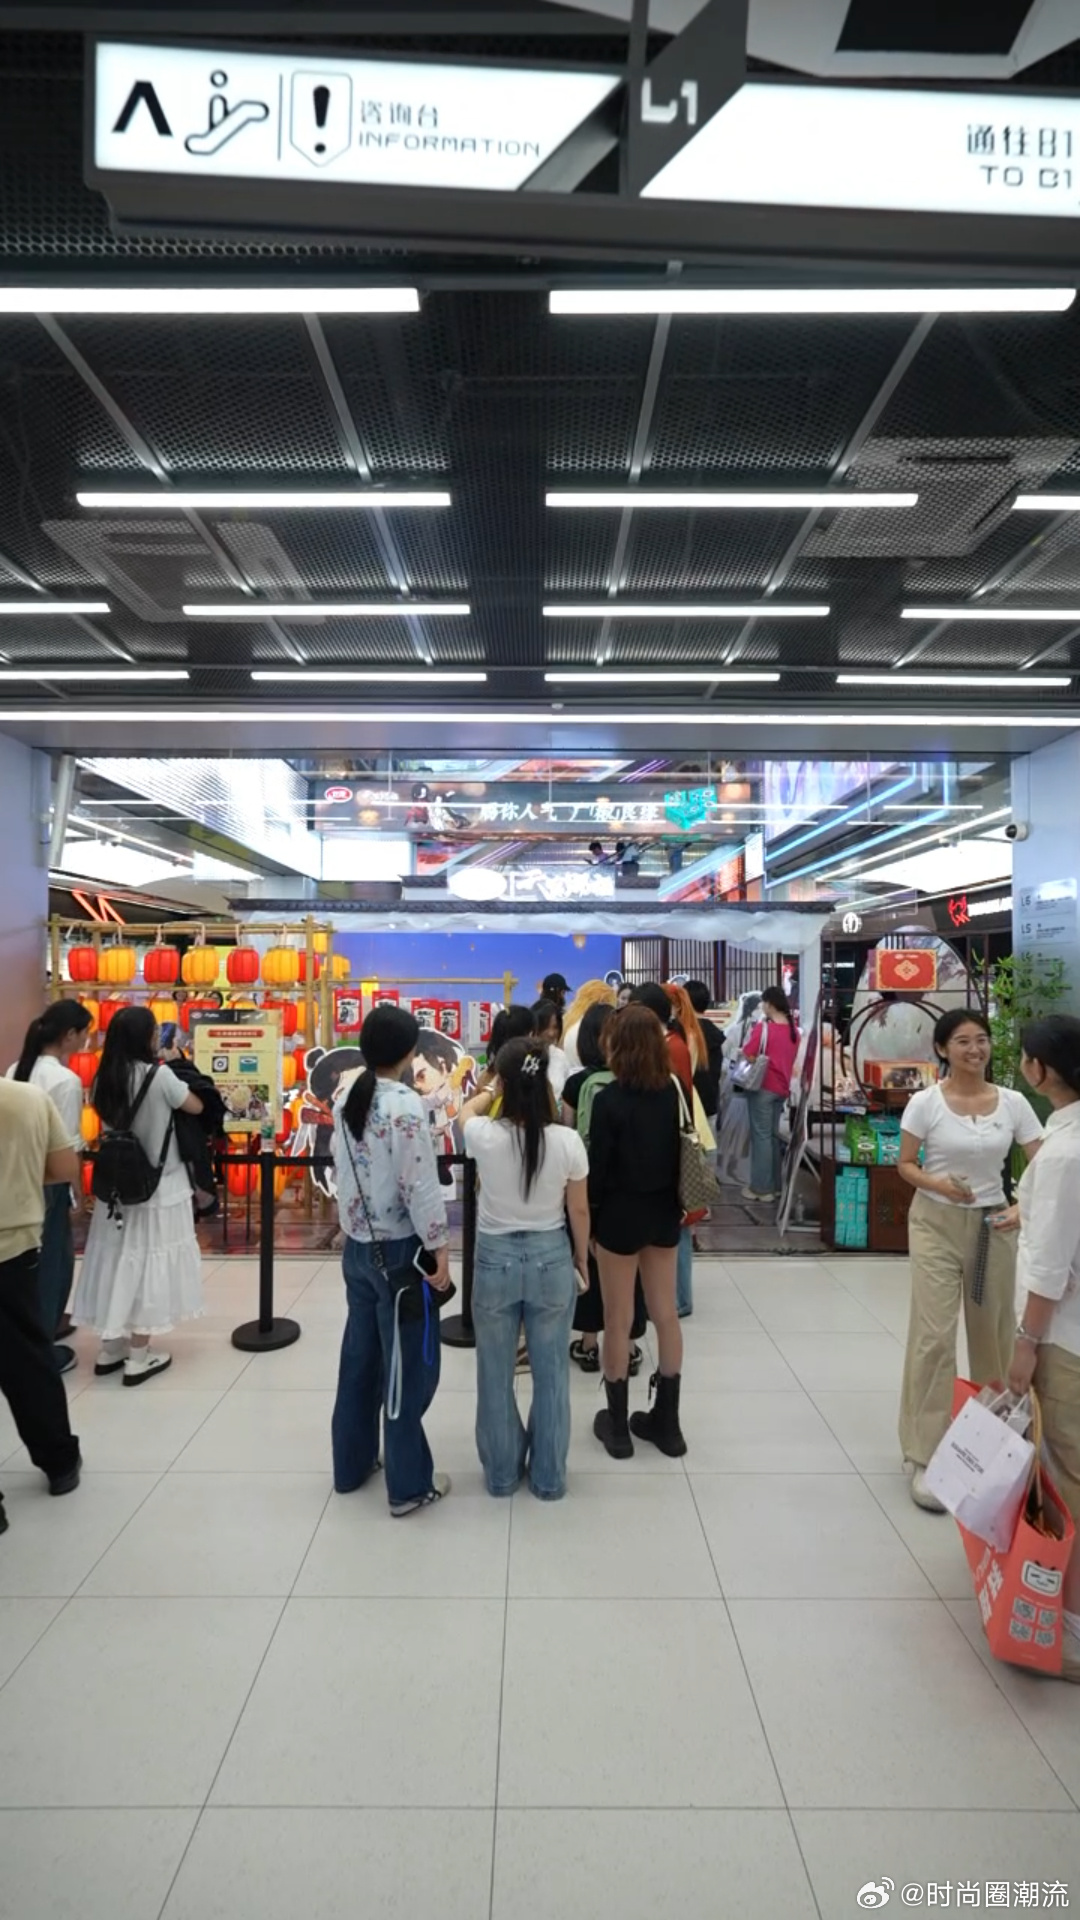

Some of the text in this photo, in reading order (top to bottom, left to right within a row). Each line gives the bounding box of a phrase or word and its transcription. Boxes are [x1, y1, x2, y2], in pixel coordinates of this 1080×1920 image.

[360, 100, 438, 128] 咨询台
[640, 77, 698, 126] L1
[358, 131, 541, 158] INFORMATION
[979, 165, 1024, 187] TO
